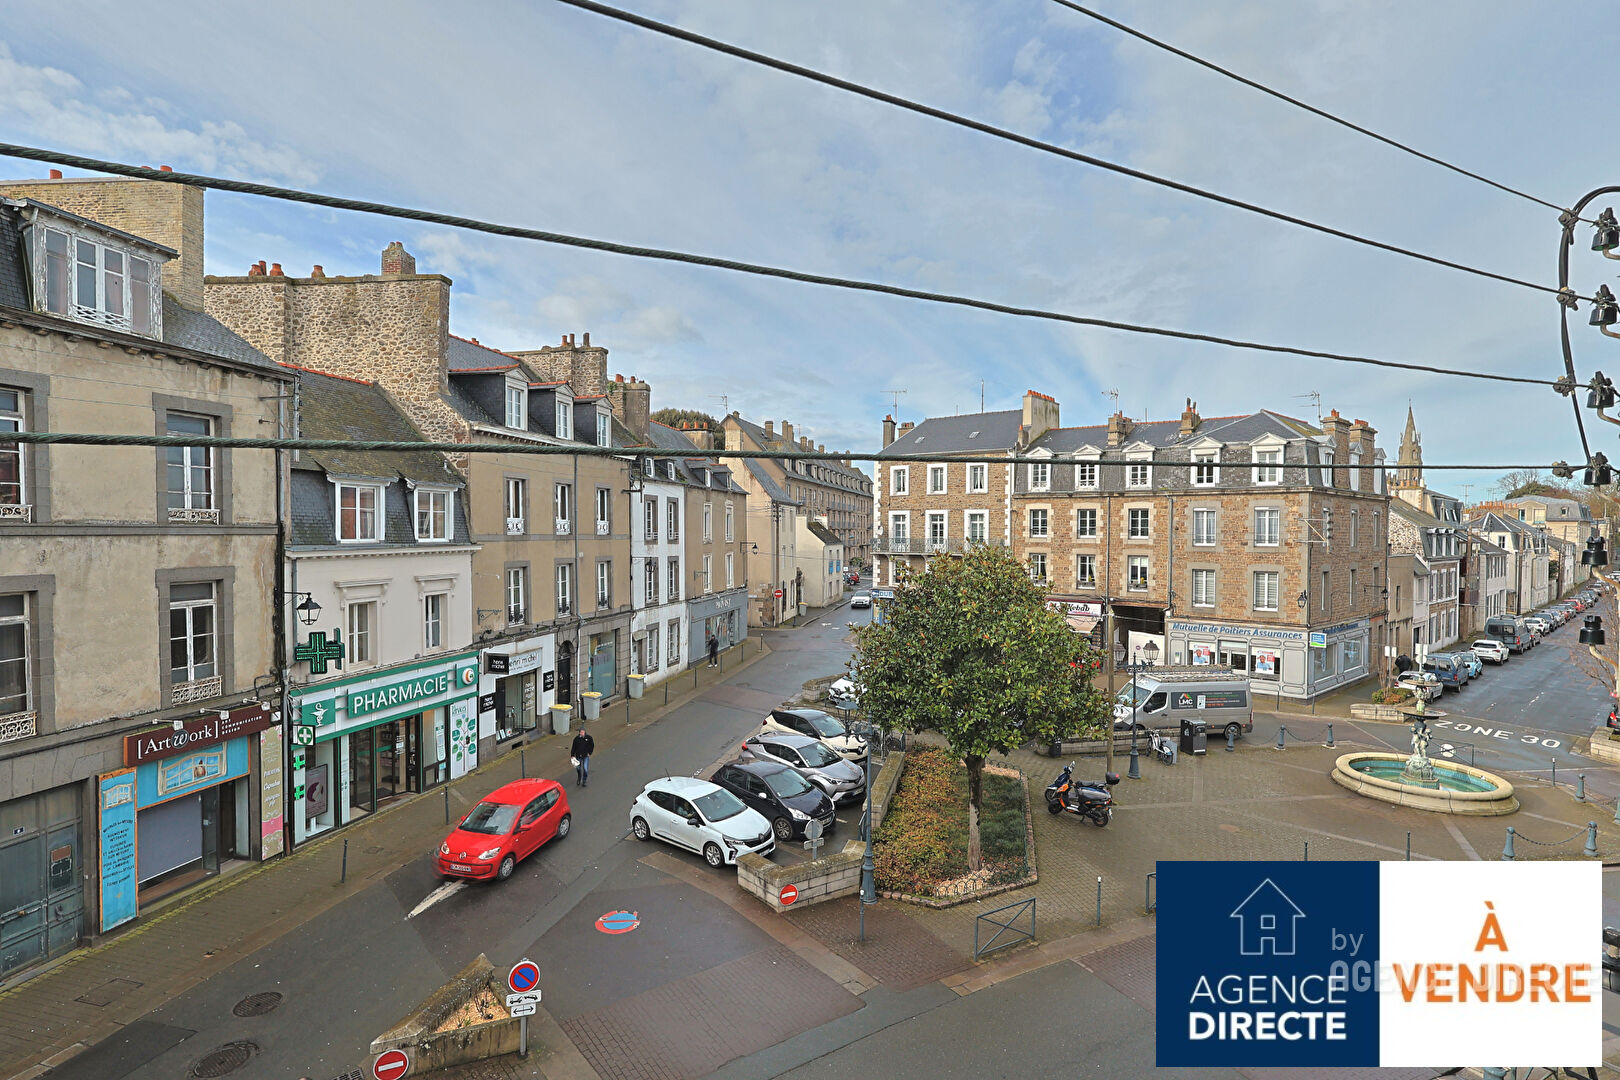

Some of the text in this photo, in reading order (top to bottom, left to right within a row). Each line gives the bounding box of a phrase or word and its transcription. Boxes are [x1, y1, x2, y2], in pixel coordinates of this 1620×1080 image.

[1172, 622, 1208, 632] Mutuelle
[1208, 625, 1219, 633] de
[1219, 626, 1251, 637] Poitiers
[1252, 627, 1303, 640] Assurances
[352, 675, 447, 714] PHARMACIE
[1433, 719, 1561, 748] ZONE 30
